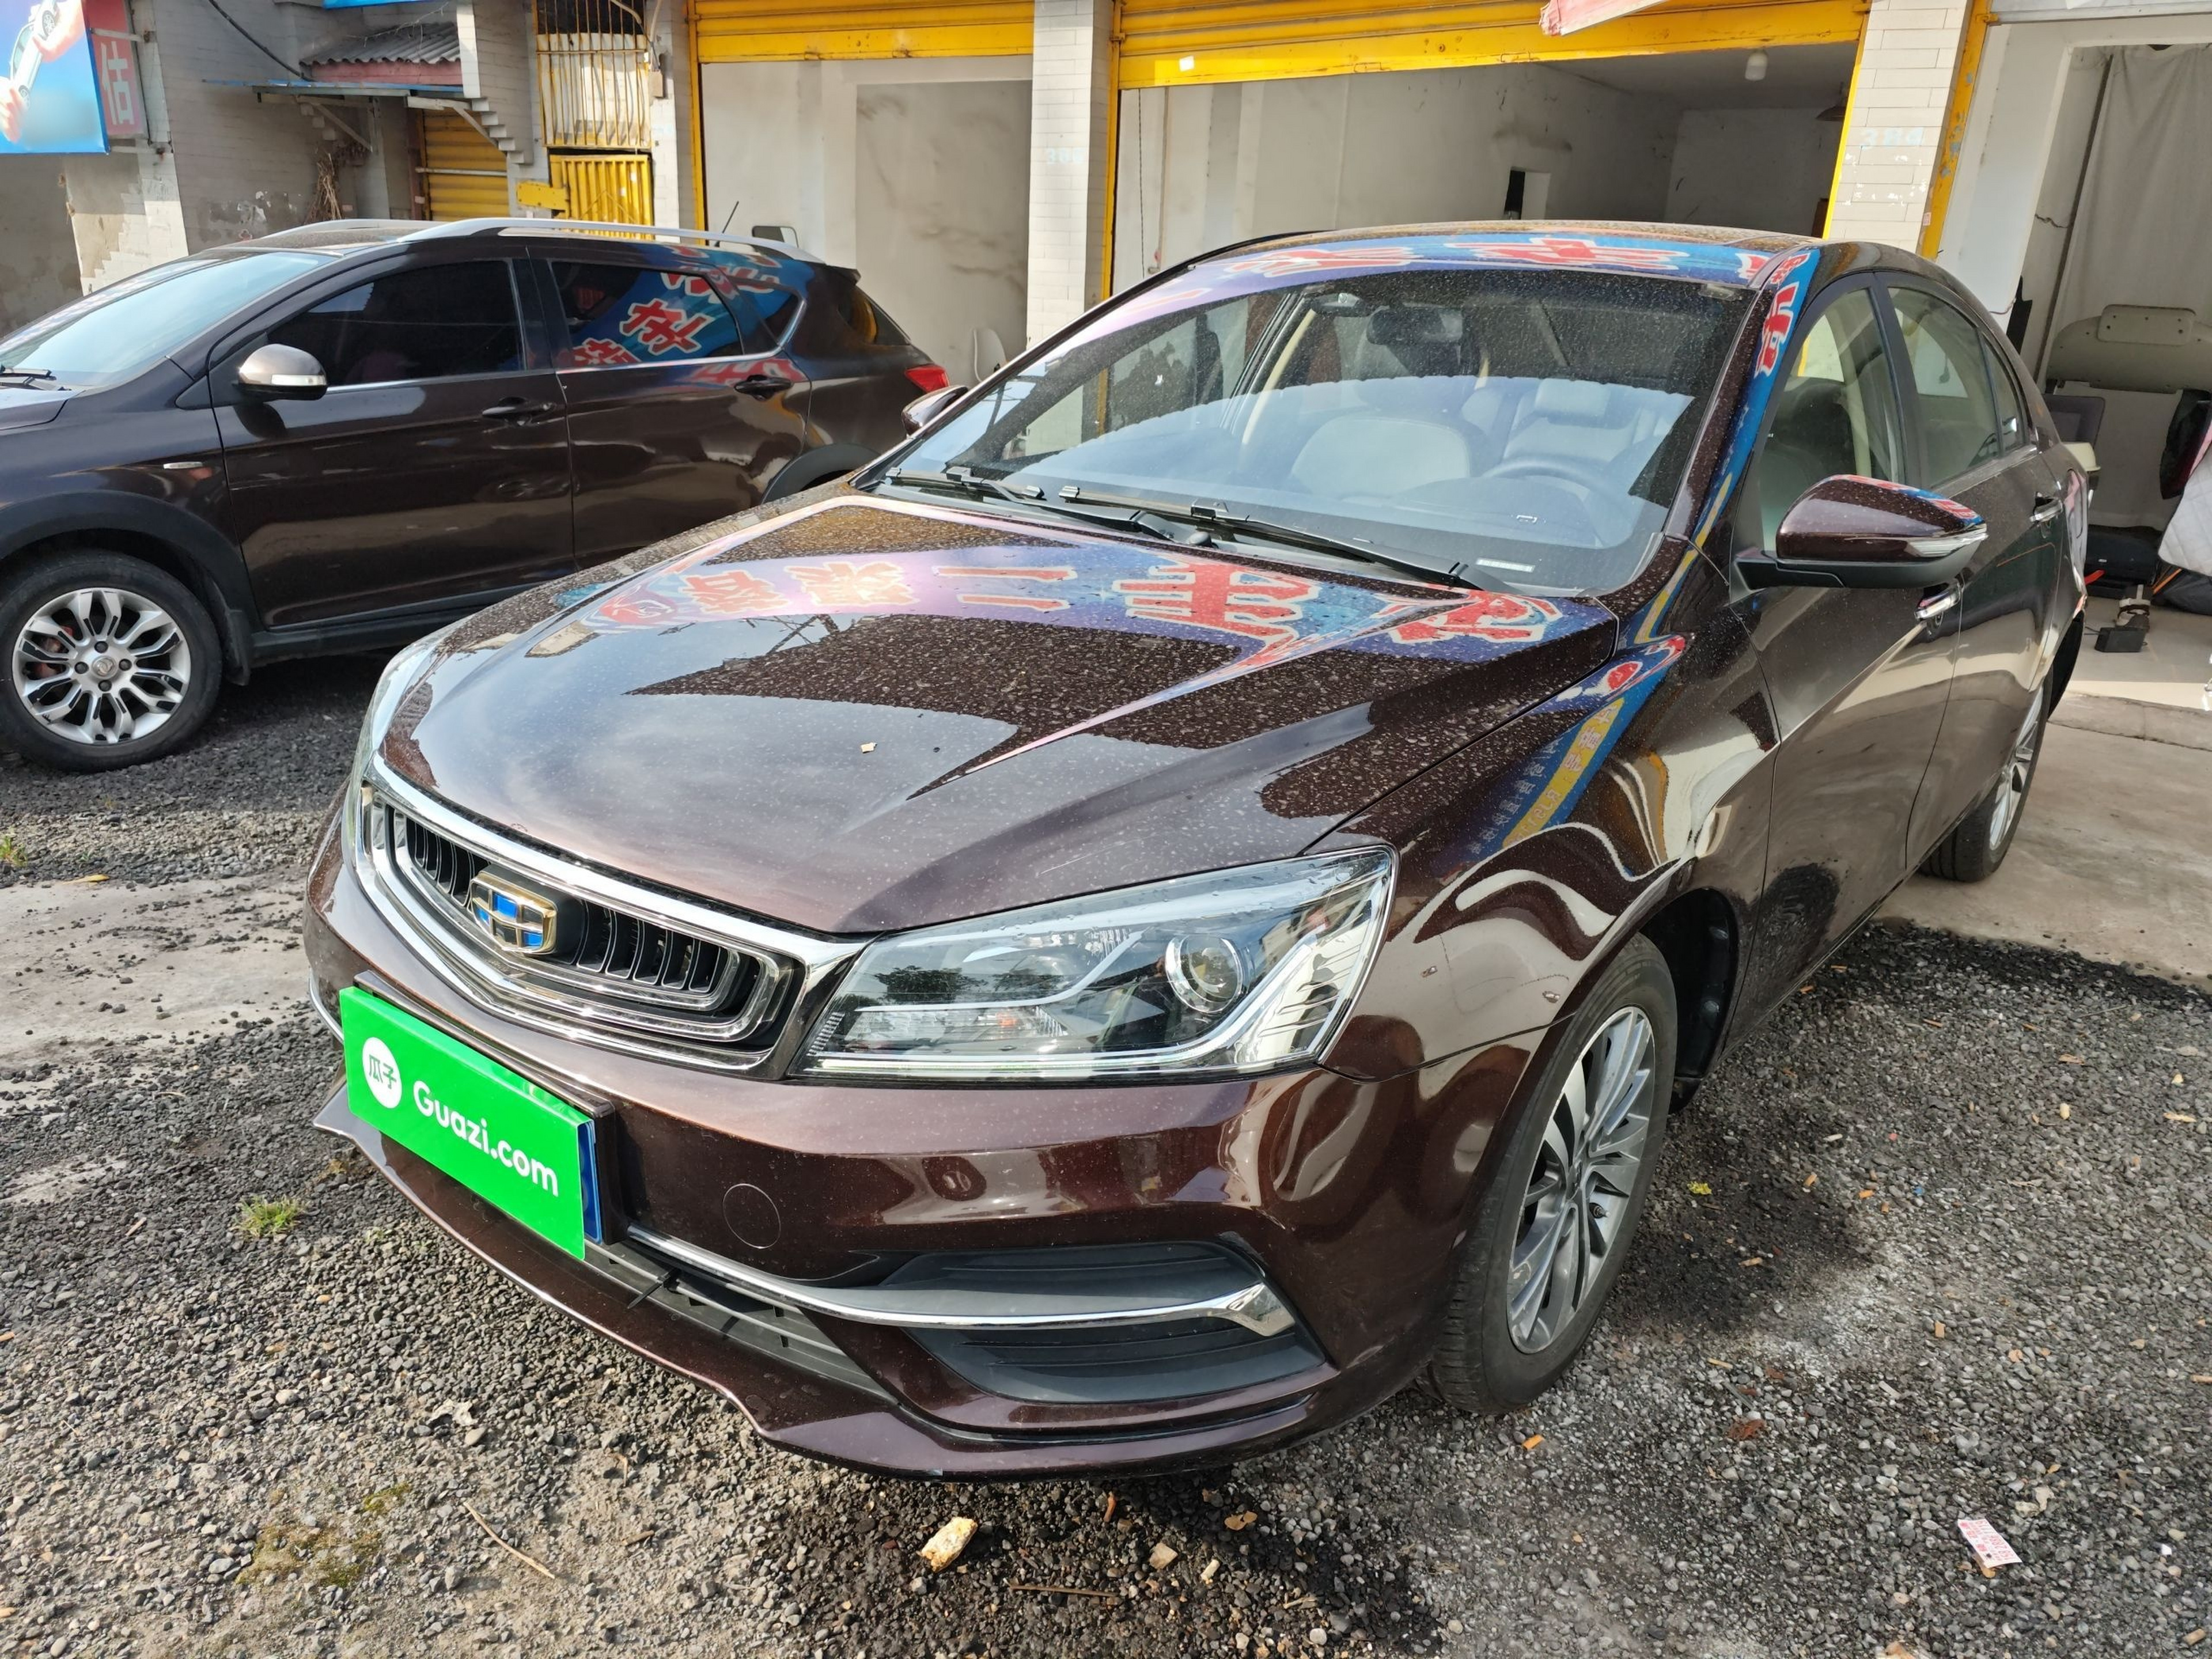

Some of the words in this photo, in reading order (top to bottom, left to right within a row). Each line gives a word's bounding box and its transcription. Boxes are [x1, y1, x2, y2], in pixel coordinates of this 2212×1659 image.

[100, 40, 135, 125] 估
[369, 1054, 397, 1090] 瓜子
[413, 1080, 559, 1198] Guazi.com
